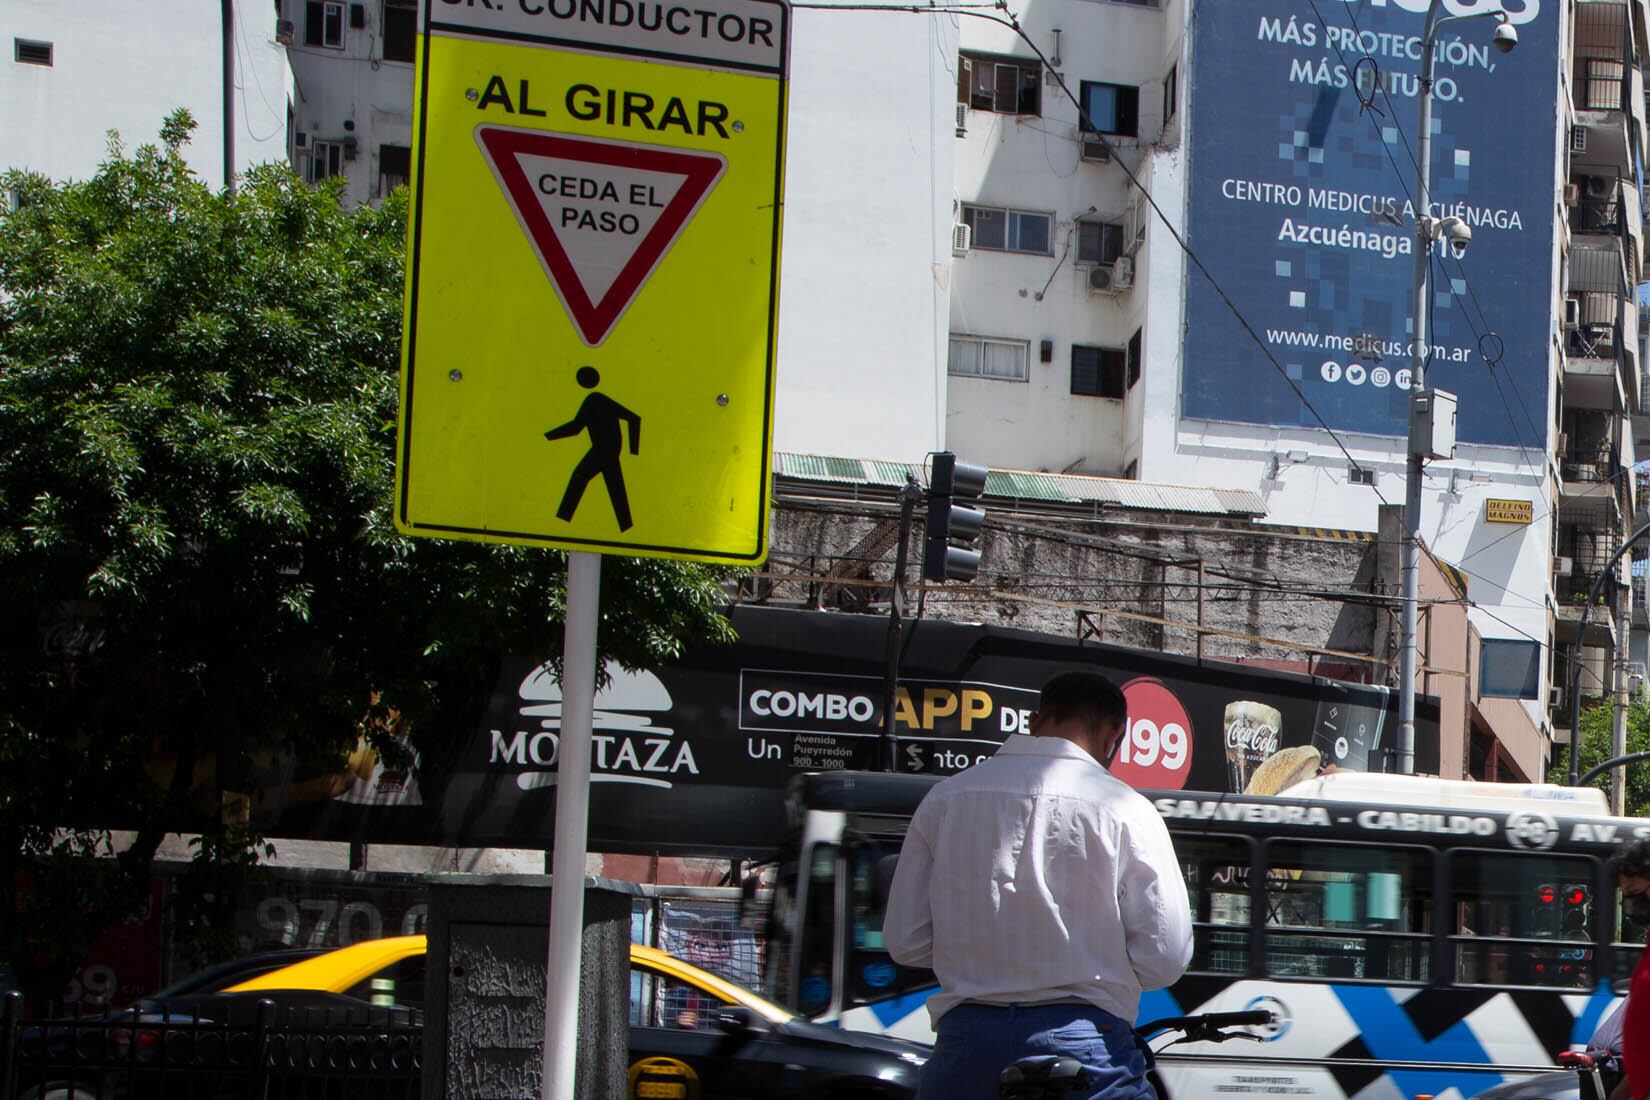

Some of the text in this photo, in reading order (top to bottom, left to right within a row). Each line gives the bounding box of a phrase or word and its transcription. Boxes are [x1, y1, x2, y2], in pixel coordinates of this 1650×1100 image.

[519, 0, 774, 47] CONDUCTOR
[1258, 15, 1496, 72] MÁS PROTECIÓN,
[1289, 57, 1464, 103] MÁS FUTUO.
[476, 75, 730, 139] AL GIRAR
[538, 174, 665, 208] CEDA EL
[1222, 179, 1522, 230] CENTRO MEDICUS ACUÉNAGA
[561, 207, 640, 235] PASO
[1278, 218, 1412, 258] Azcuénaga
[1266, 329, 1472, 363] www.medicus.cm.ar
[1489, 512, 1530, 520] MAGNUS
[749, 687, 1031, 735] COMBO APP DE
[489, 730, 700, 774] MOTAZA
[747, 738, 782, 760] Un
[793, 744, 853, 758] Pueyrredón
[794, 735, 837, 746] Avenida
[793, 757, 812, 768] 900
[822, 759, 845, 769] 1000
[1158, 798, 1332, 827] SAAVEDRA
[1357, 810, 1497, 836] CABILDO
[1569, 822, 1624, 844] AV.
